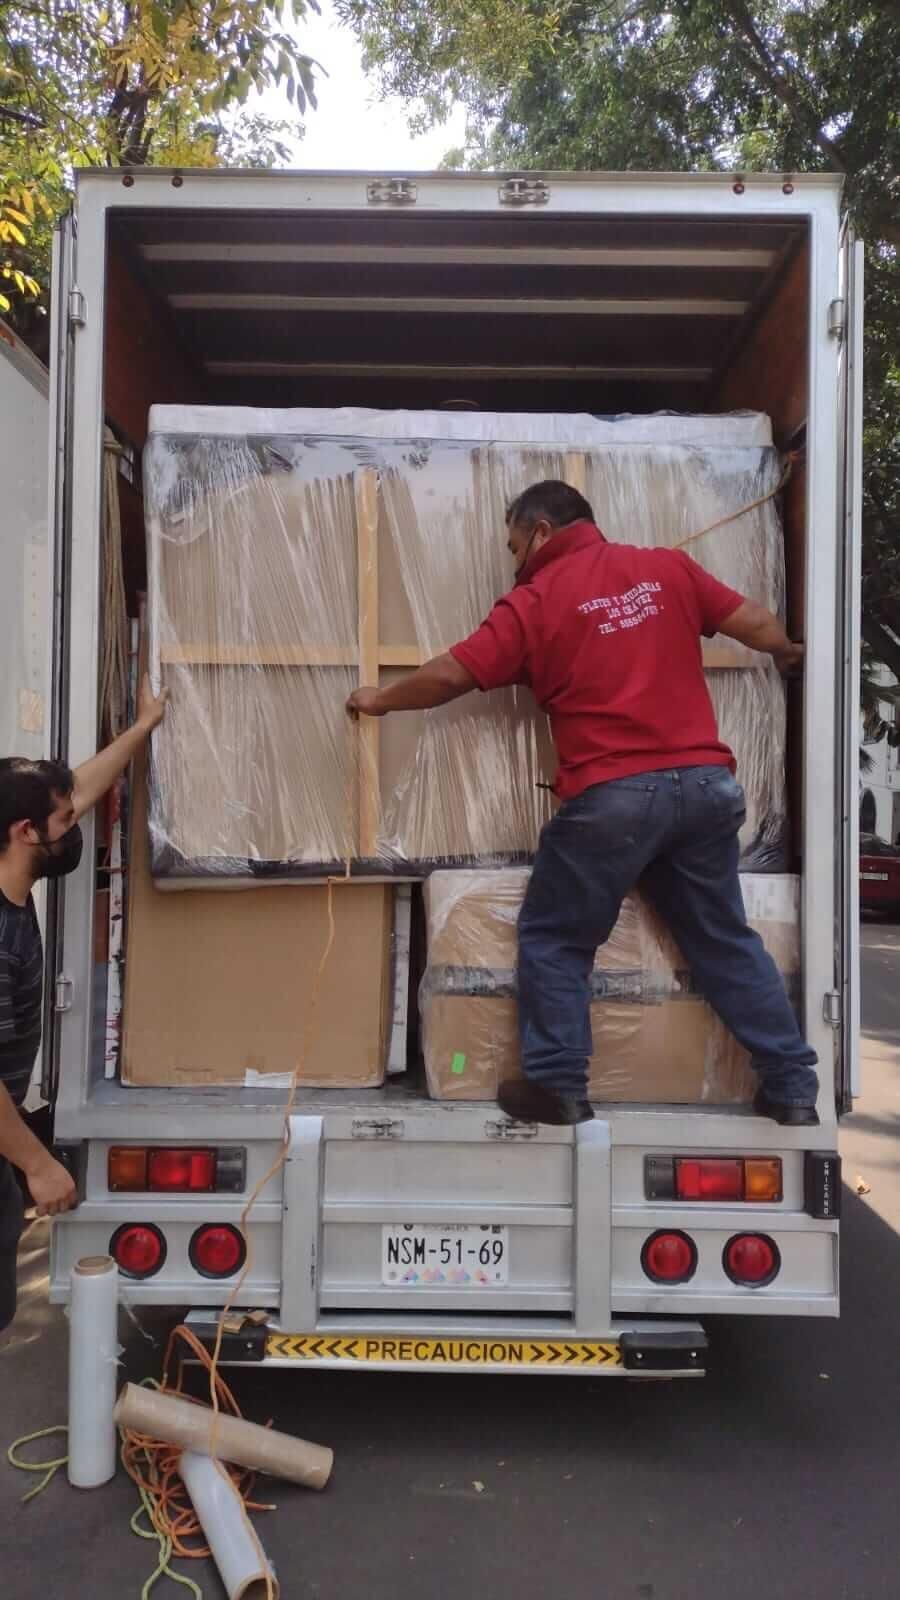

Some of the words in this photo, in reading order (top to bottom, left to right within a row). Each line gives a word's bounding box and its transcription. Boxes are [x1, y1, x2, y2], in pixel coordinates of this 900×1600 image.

[606, 607, 621, 619] LOS
[387, 1237, 504, 1265] NSM-51-69
[366, 1340, 524, 1363] PRECAUCION
